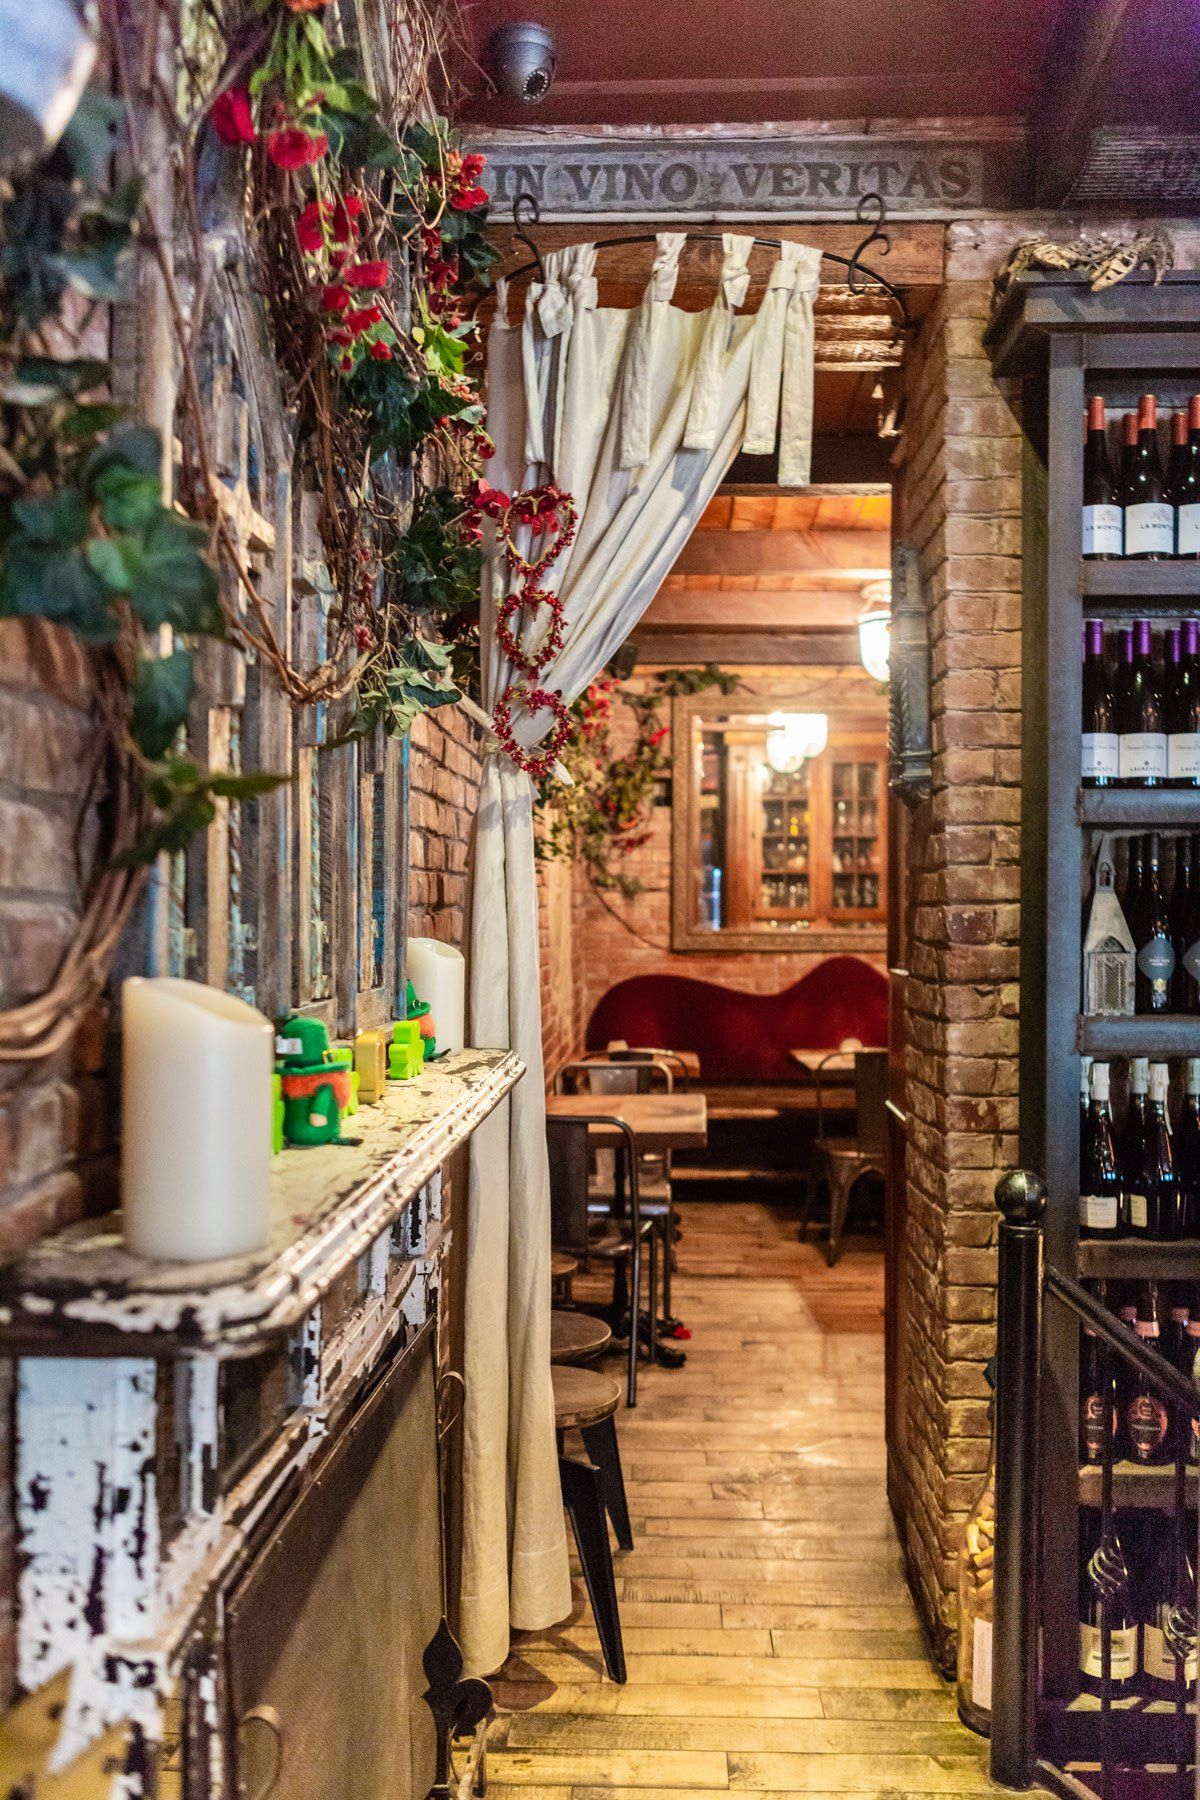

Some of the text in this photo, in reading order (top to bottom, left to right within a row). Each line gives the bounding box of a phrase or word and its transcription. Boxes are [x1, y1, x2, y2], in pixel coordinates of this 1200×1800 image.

[491, 160, 972, 203] IN VINO VERITAS
